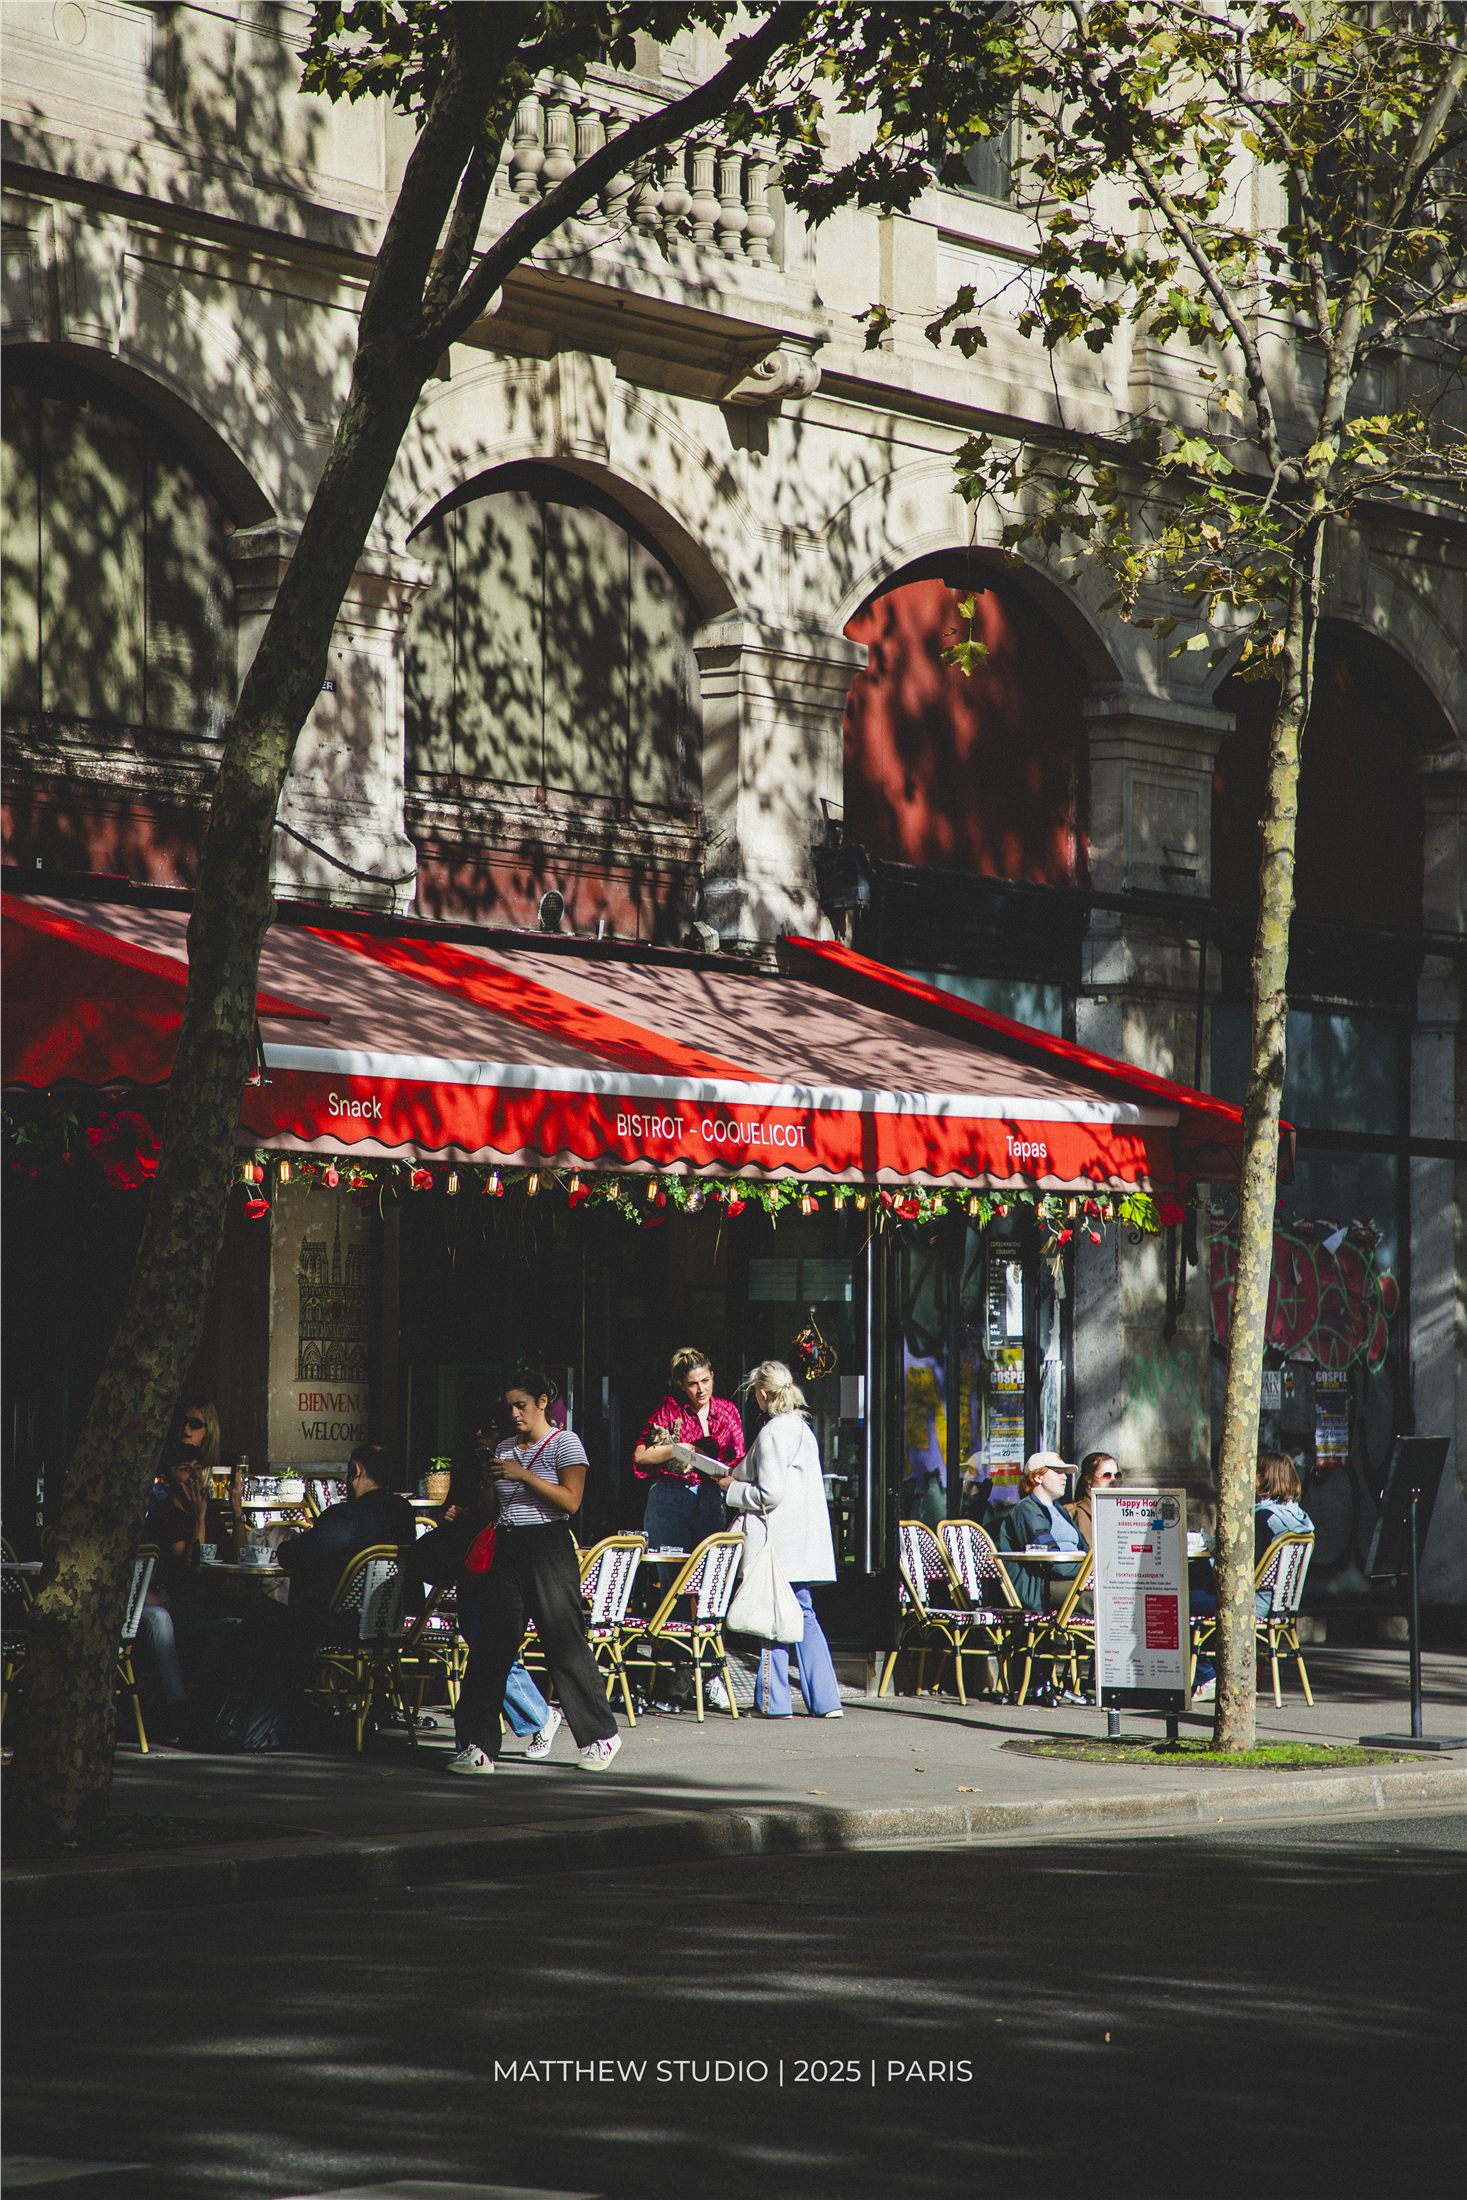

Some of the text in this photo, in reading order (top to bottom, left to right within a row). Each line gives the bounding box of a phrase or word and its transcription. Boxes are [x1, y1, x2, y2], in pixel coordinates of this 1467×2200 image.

[328, 1092, 383, 1119] Snack
[617, 1113, 684, 1140] BISTROT
[701, 1119, 806, 1148] COQUELICOT
[1005, 1135, 1047, 1162] Tapas
[1315, 1371, 1348, 1383] GOSPEL
[1263, 1382, 1279, 1393] AIX
[298, 1392, 368, 1412] BIENVENU
[301, 1422, 368, 1441] WELCOME
[1116, 1498, 1140, 1509] Happy
[1142, 1498, 1158, 1507] Hou
[1121, 1508, 1134, 1517] 15h
[1140, 1508, 1156, 1517] 02h
